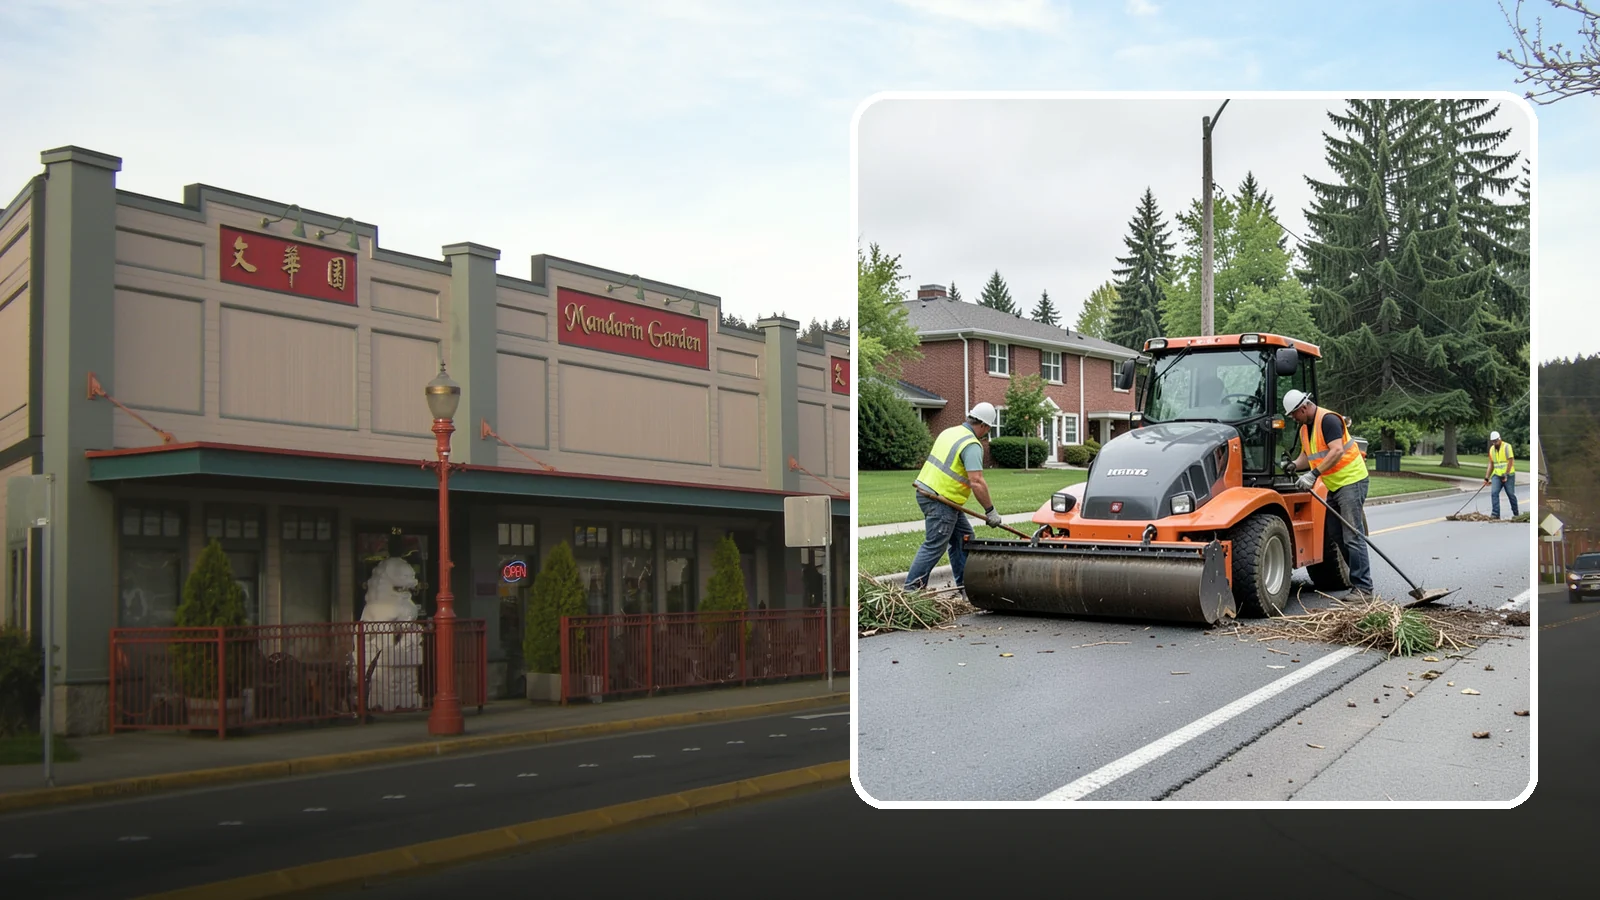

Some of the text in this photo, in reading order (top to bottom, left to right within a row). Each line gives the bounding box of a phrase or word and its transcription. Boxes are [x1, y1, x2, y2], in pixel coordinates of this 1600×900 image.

[231, 236, 346, 291] 文華園
[564, 302, 701, 352] Mandarin Garden
[503, 565, 527, 578] OPEN
